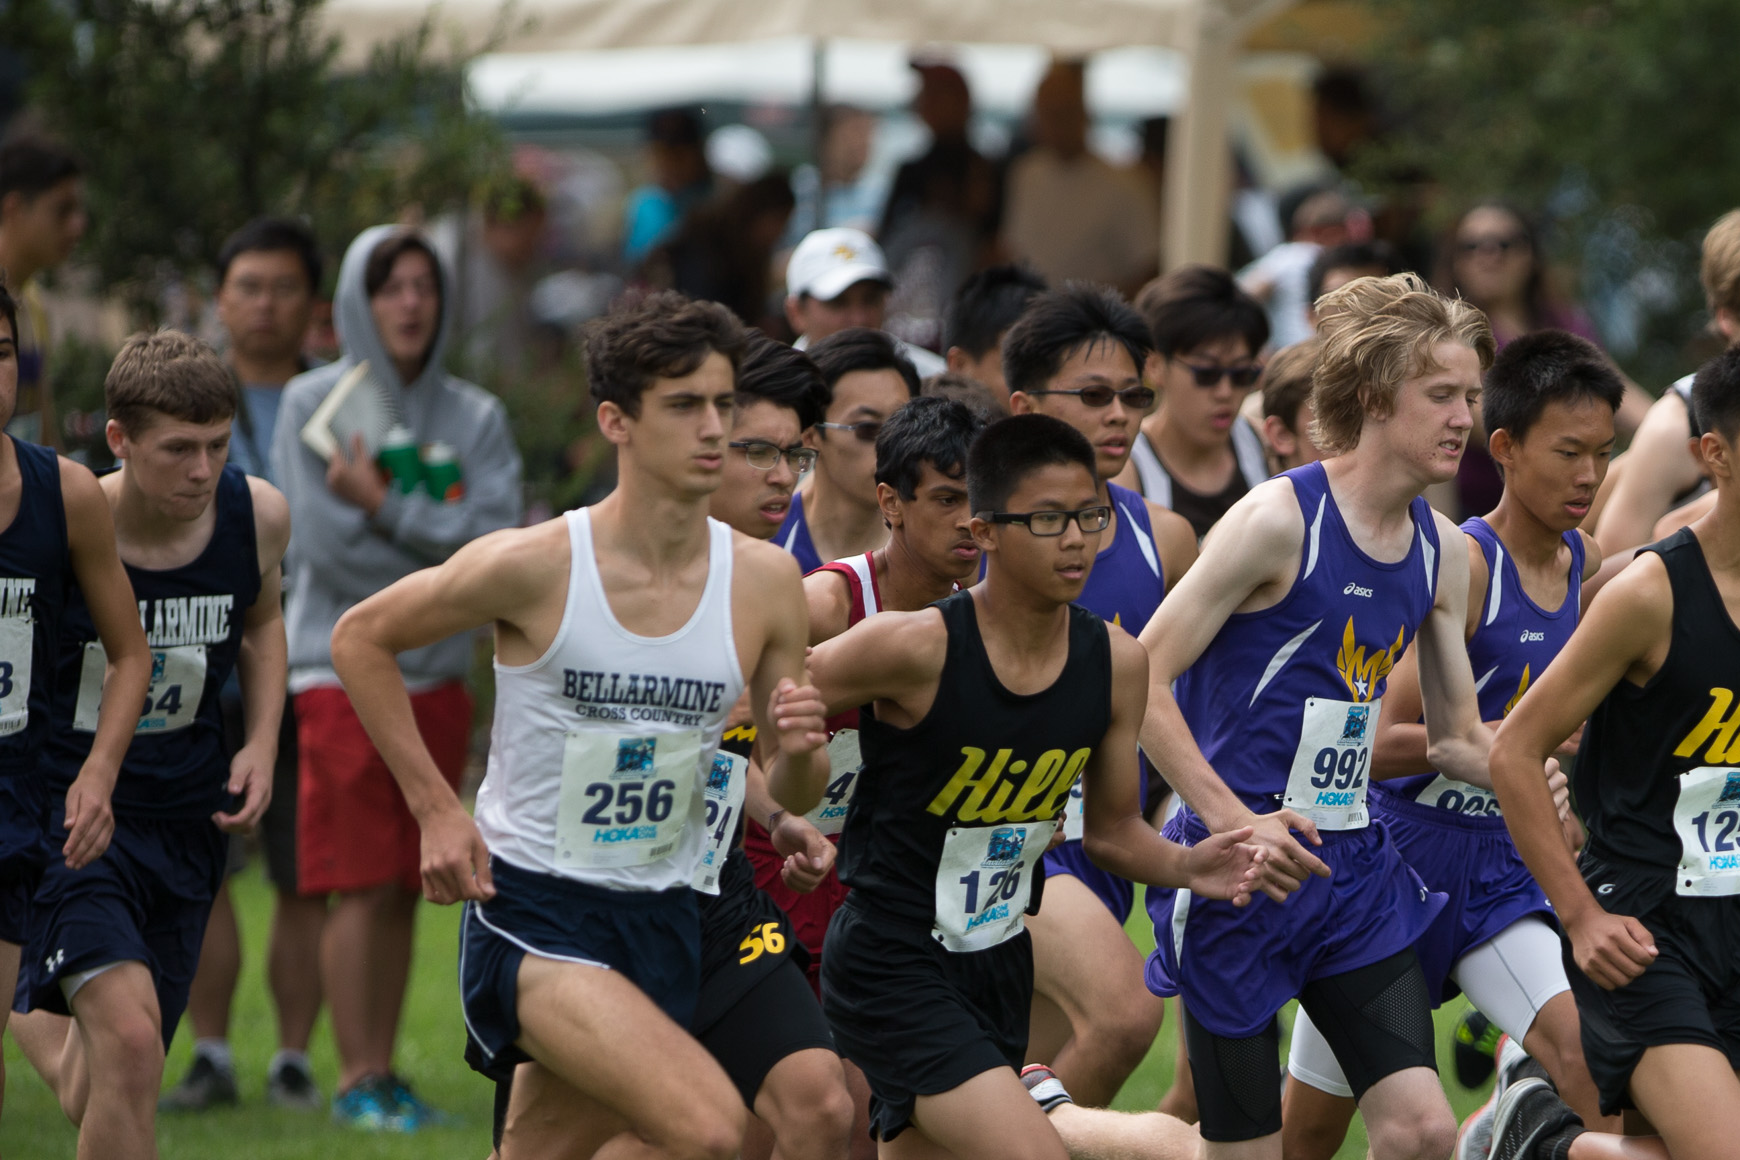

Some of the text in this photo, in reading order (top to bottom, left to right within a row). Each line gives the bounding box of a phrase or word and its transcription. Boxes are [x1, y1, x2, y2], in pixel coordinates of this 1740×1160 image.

[139, 595, 234, 646] LARMINE
[562, 668, 726, 713] BELLARMINE
[575, 704, 703, 726] CROSS COUNTRY
[925, 746, 1091, 823] Hill
[1310, 747, 1368, 789] 992
[581, 779, 676, 826] 256
[1315, 791, 1348, 806] HOKA
[593, 826, 640, 844] HOKA
[960, 860, 1024, 914] 126
[739, 922, 786, 965] 56
